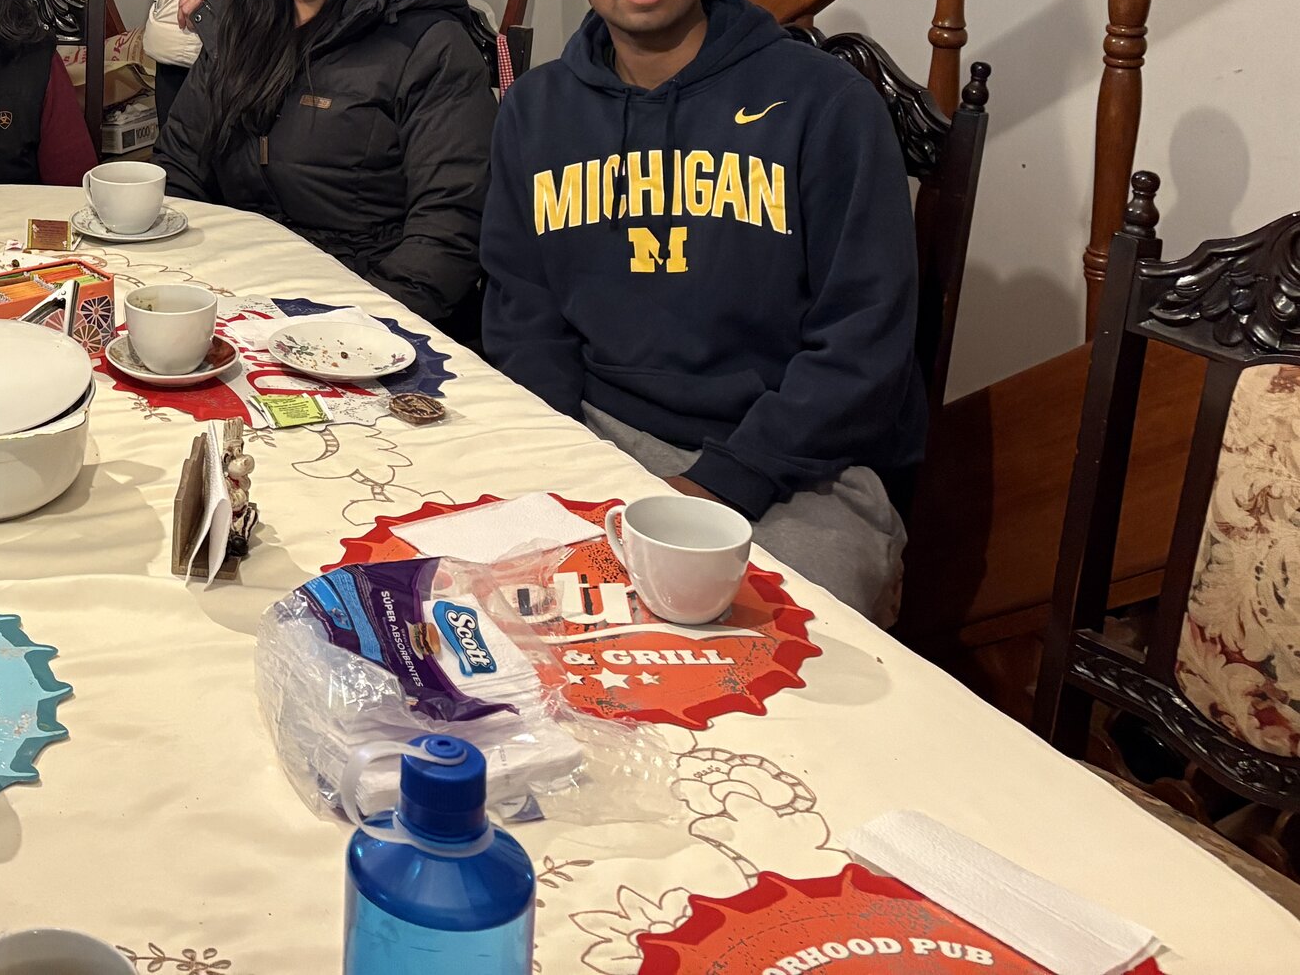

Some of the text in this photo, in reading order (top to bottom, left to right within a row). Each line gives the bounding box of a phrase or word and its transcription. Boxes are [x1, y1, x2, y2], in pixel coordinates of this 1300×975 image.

[533, 149, 787, 236] MICHIGAN
[627, 227, 688, 273] M
[380, 590, 396, 625] SÚPER
[391, 624, 424, 688] ABSORBENTES
[446, 610, 492, 668] Scott
[561, 649, 597, 665] &
[601, 649, 735, 665] GRILL
[908, 937, 995, 966] PUB
